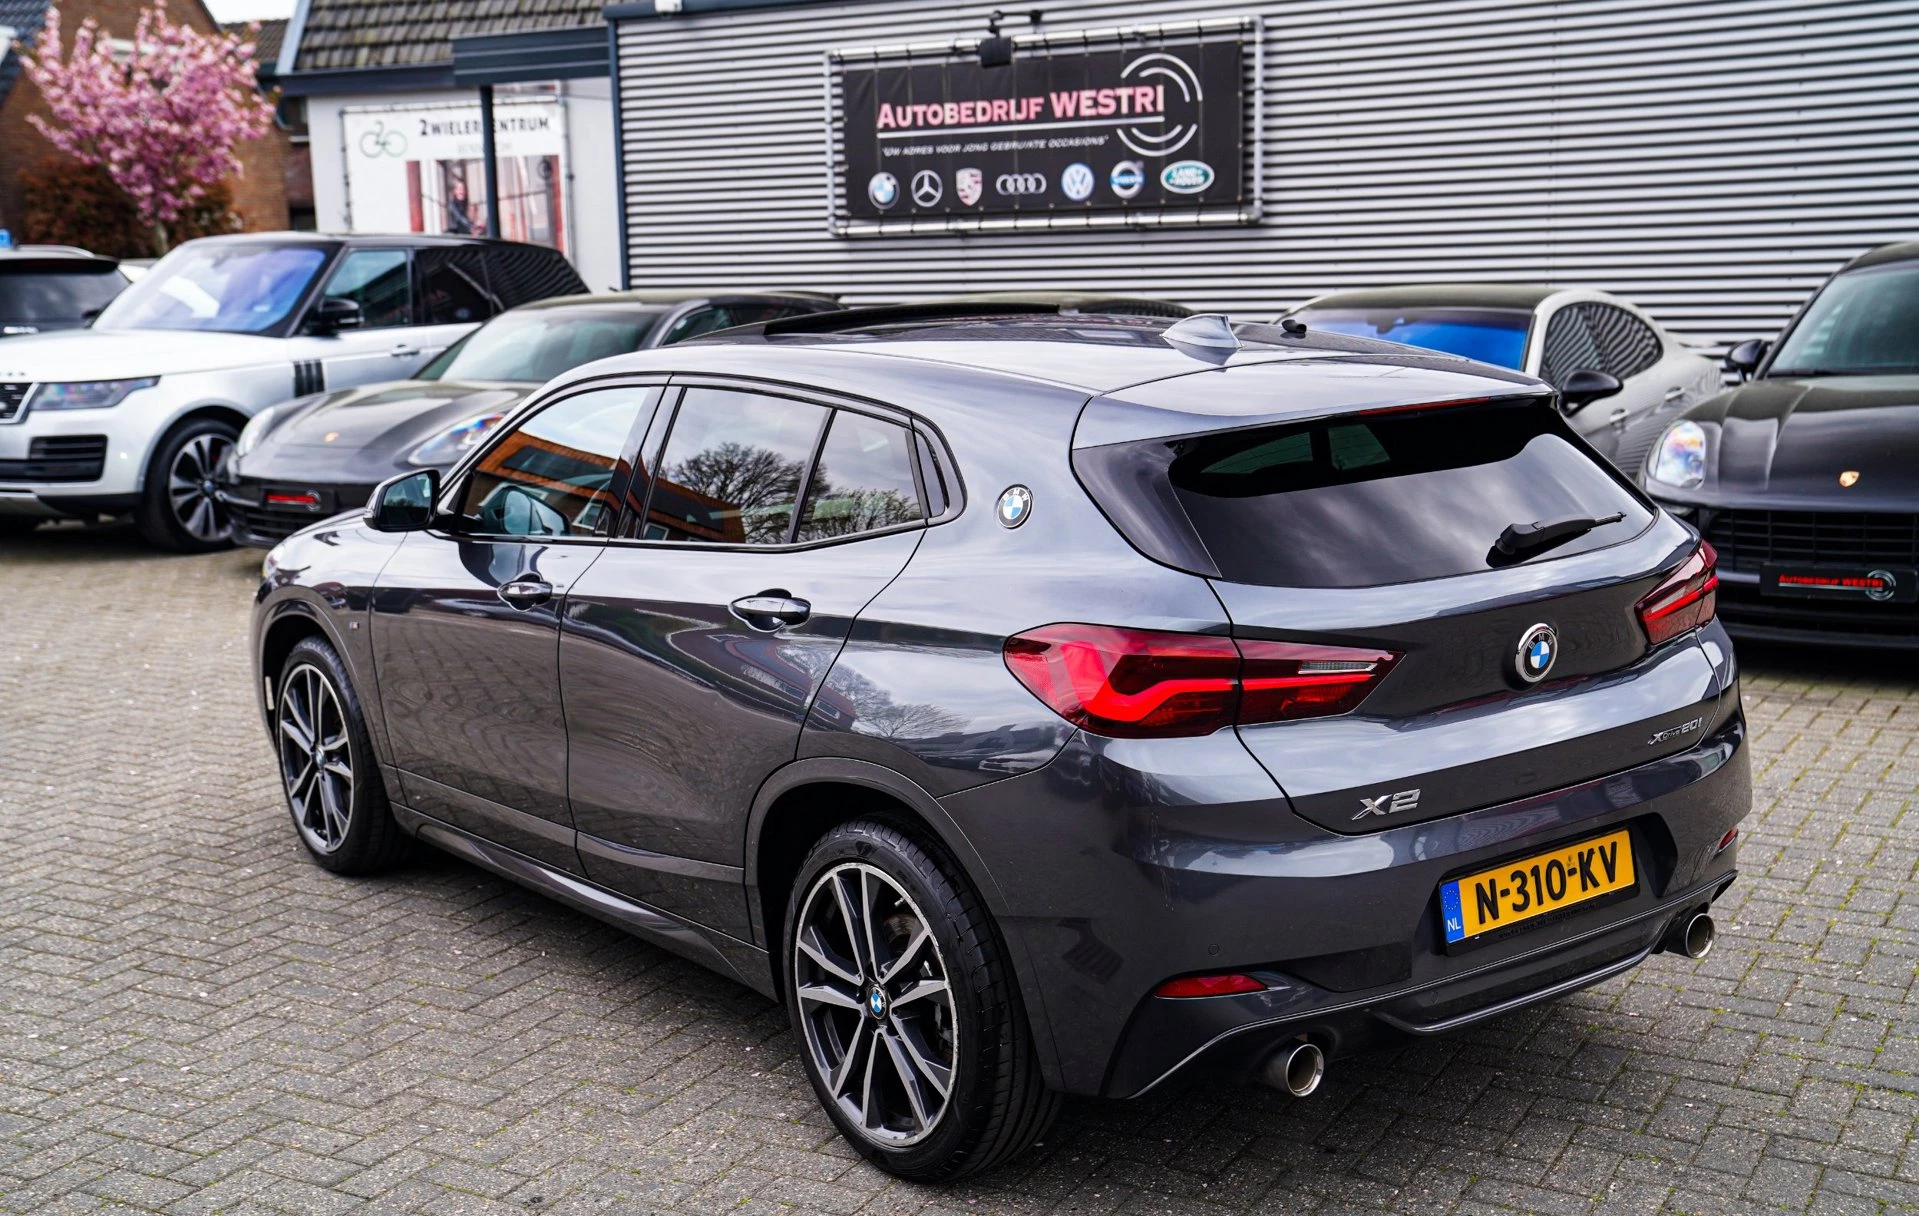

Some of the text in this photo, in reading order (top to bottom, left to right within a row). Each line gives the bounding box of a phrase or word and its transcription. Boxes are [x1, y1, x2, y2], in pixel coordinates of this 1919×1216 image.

[876, 85, 1165, 130] AUTOBEDRIJF WESTRI
[903, 146, 935, 156] ADRES
[936, 144, 961, 154] VOOR
[962, 142, 989, 153] JONG
[1528, 633, 1554, 650] BMW
[1351, 788, 1421, 820] X2
[1475, 841, 1618, 925] N-310-KV
[1447, 917, 1462, 932] NL
